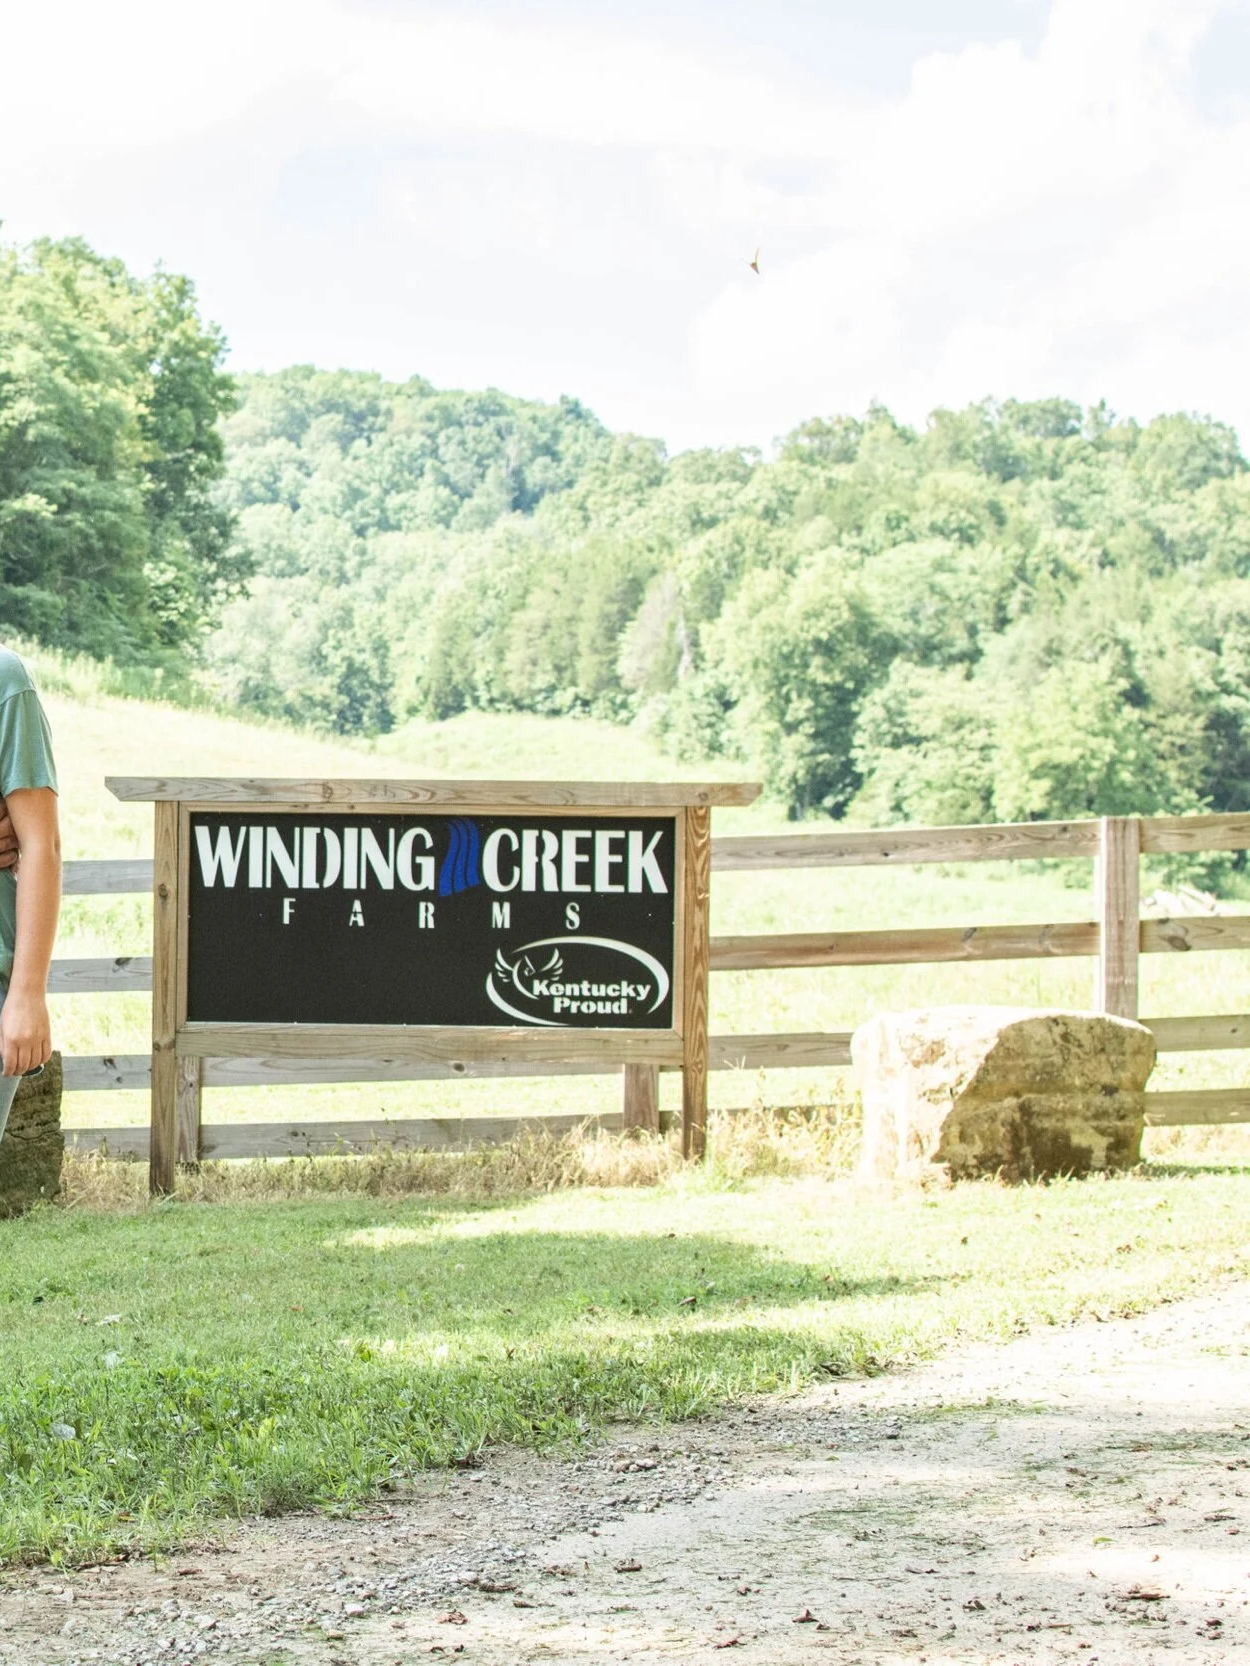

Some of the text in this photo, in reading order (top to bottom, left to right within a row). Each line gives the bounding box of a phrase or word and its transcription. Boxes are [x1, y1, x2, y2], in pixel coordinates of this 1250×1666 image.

[194, 825, 668, 894] WINDING CREEK
[282, 898, 580, 929] FARMS
[533, 979, 651, 1001] Kentucky
[553, 997, 627, 1014] Proud
